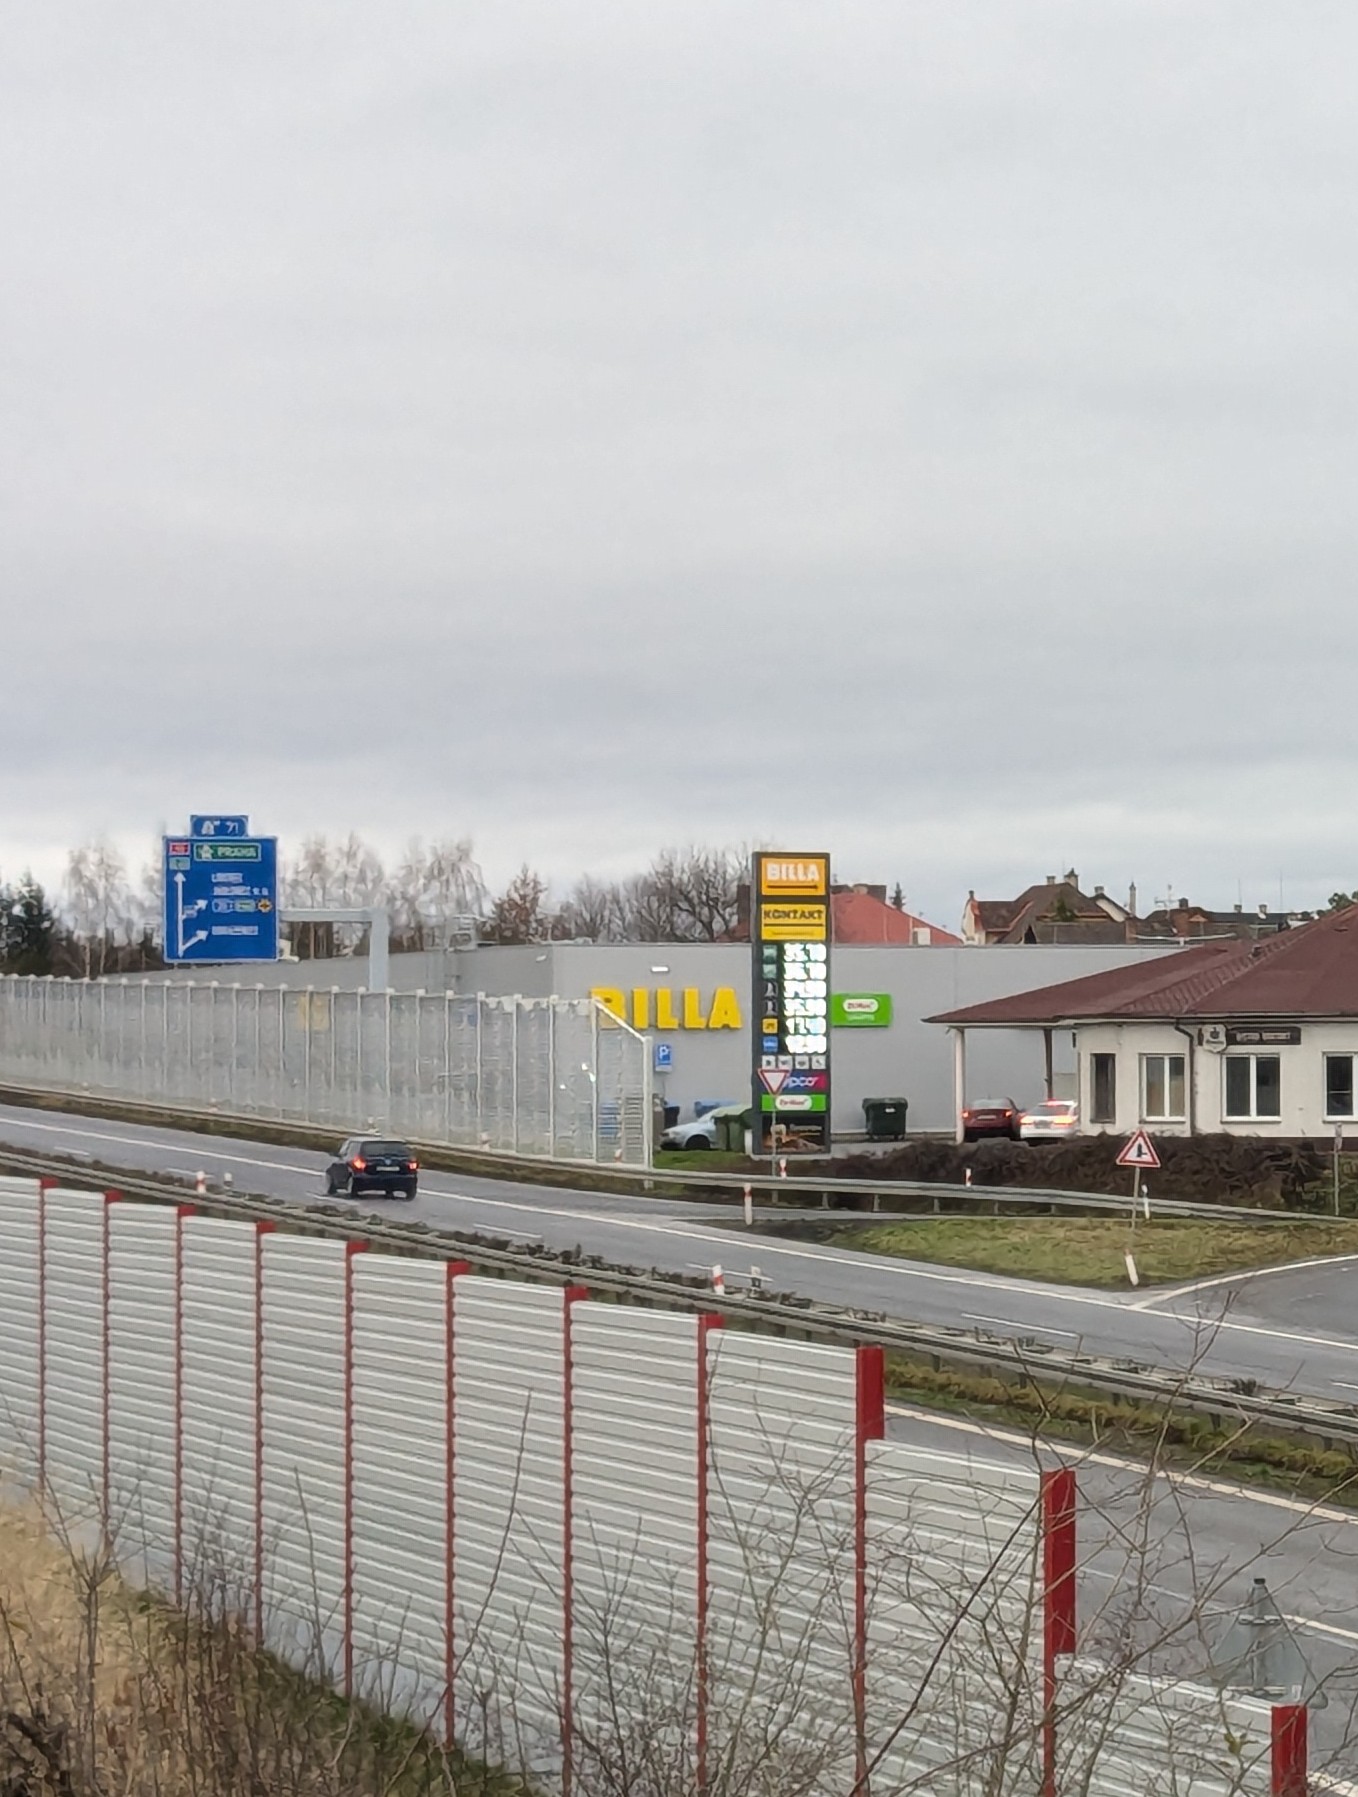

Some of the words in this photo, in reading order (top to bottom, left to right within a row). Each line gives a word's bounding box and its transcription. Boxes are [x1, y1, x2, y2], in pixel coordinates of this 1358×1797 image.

[767, 863, 820, 881] BILLA
[763, 909, 823, 920] KONTAKT
[591, 987, 743, 1029] BILLA
